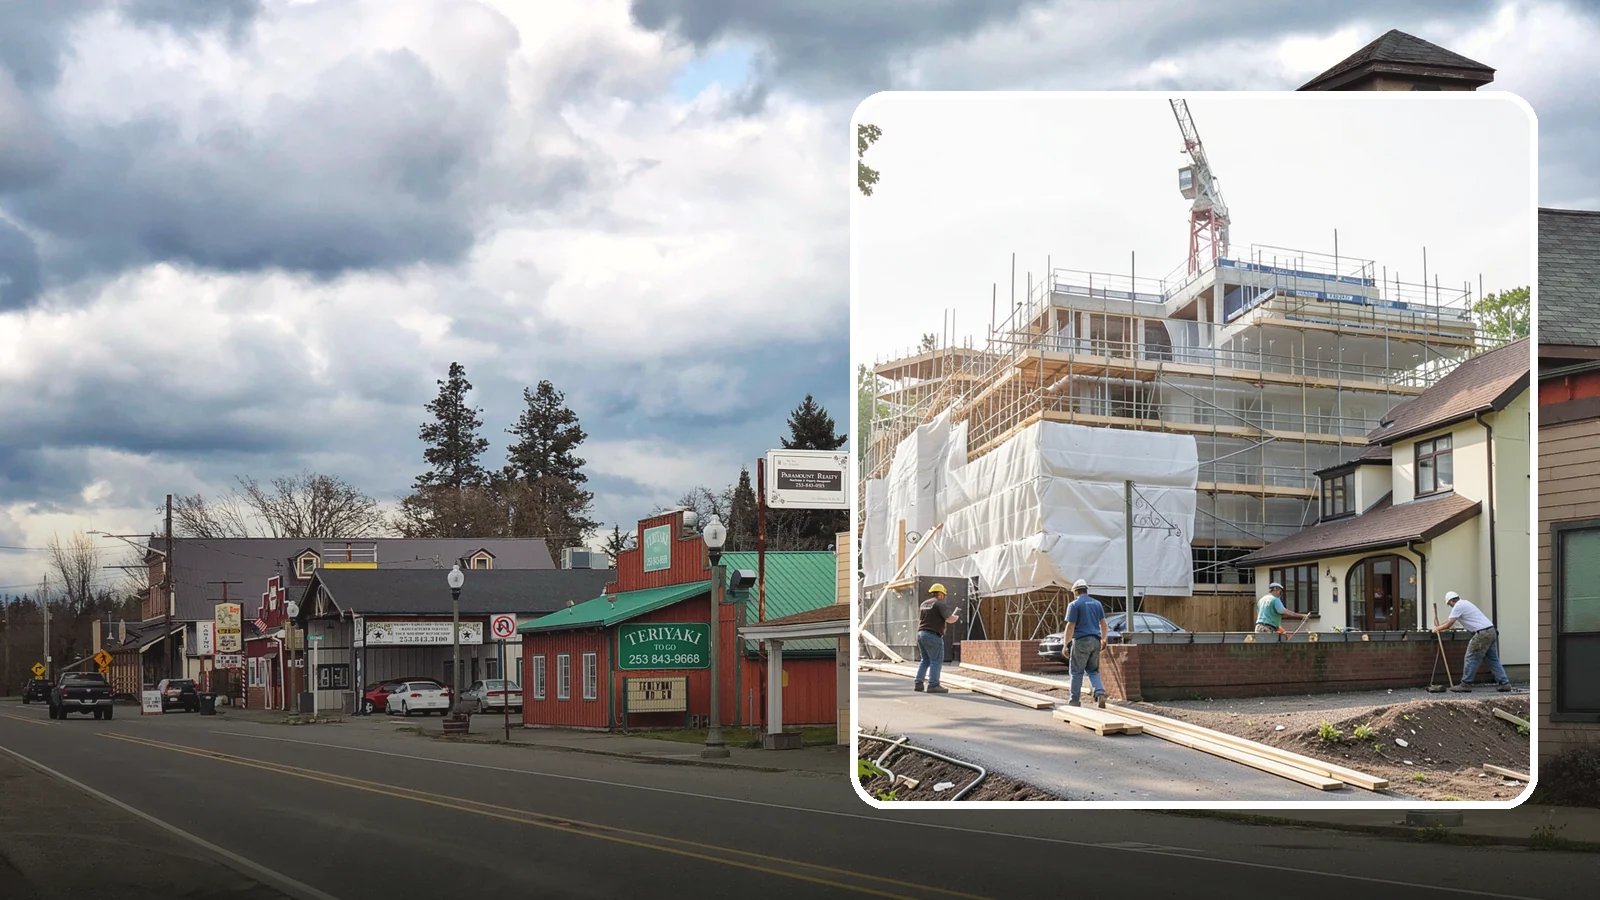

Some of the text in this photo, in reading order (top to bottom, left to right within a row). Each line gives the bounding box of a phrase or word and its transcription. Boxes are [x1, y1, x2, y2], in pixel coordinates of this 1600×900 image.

[625, 627, 702, 645] TERIYAKI
[629, 653, 700, 664] 253 843-9668
